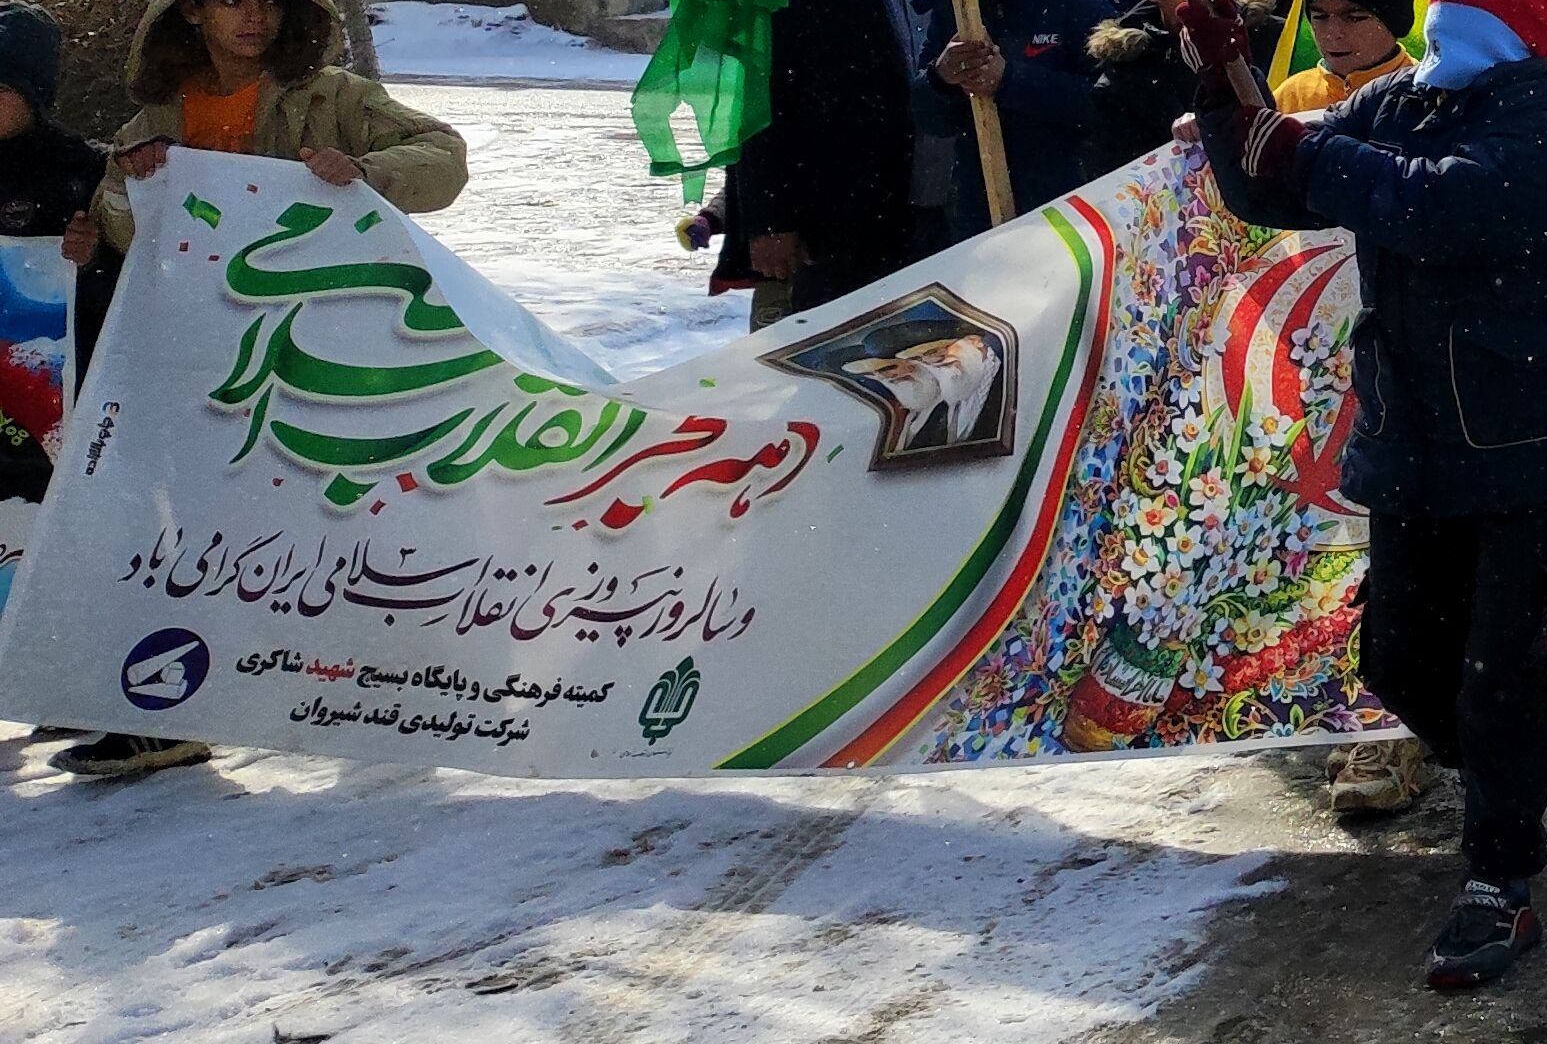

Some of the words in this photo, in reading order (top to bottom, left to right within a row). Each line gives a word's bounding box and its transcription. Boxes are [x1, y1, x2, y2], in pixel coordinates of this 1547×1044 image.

[1032, 33, 1059, 45] NIKE
[118, 526, 184, 591] باد
[344, 554, 552, 636] انقلاب
[236, 649, 303, 677] شاکری
[306, 656, 355, 683] شهید
[357, 663, 408, 689] بسیج
[412, 664, 467, 702] پایگاه
[467, 683, 481, 702] و
[485, 675, 561, 707] فرهنگی
[564, 681, 615, 708] کمیته
[289, 696, 361, 728] شیروان
[363, 702, 401, 728] قند
[400, 712, 474, 741] تولیدی
[475, 717, 530, 747] شرکت
